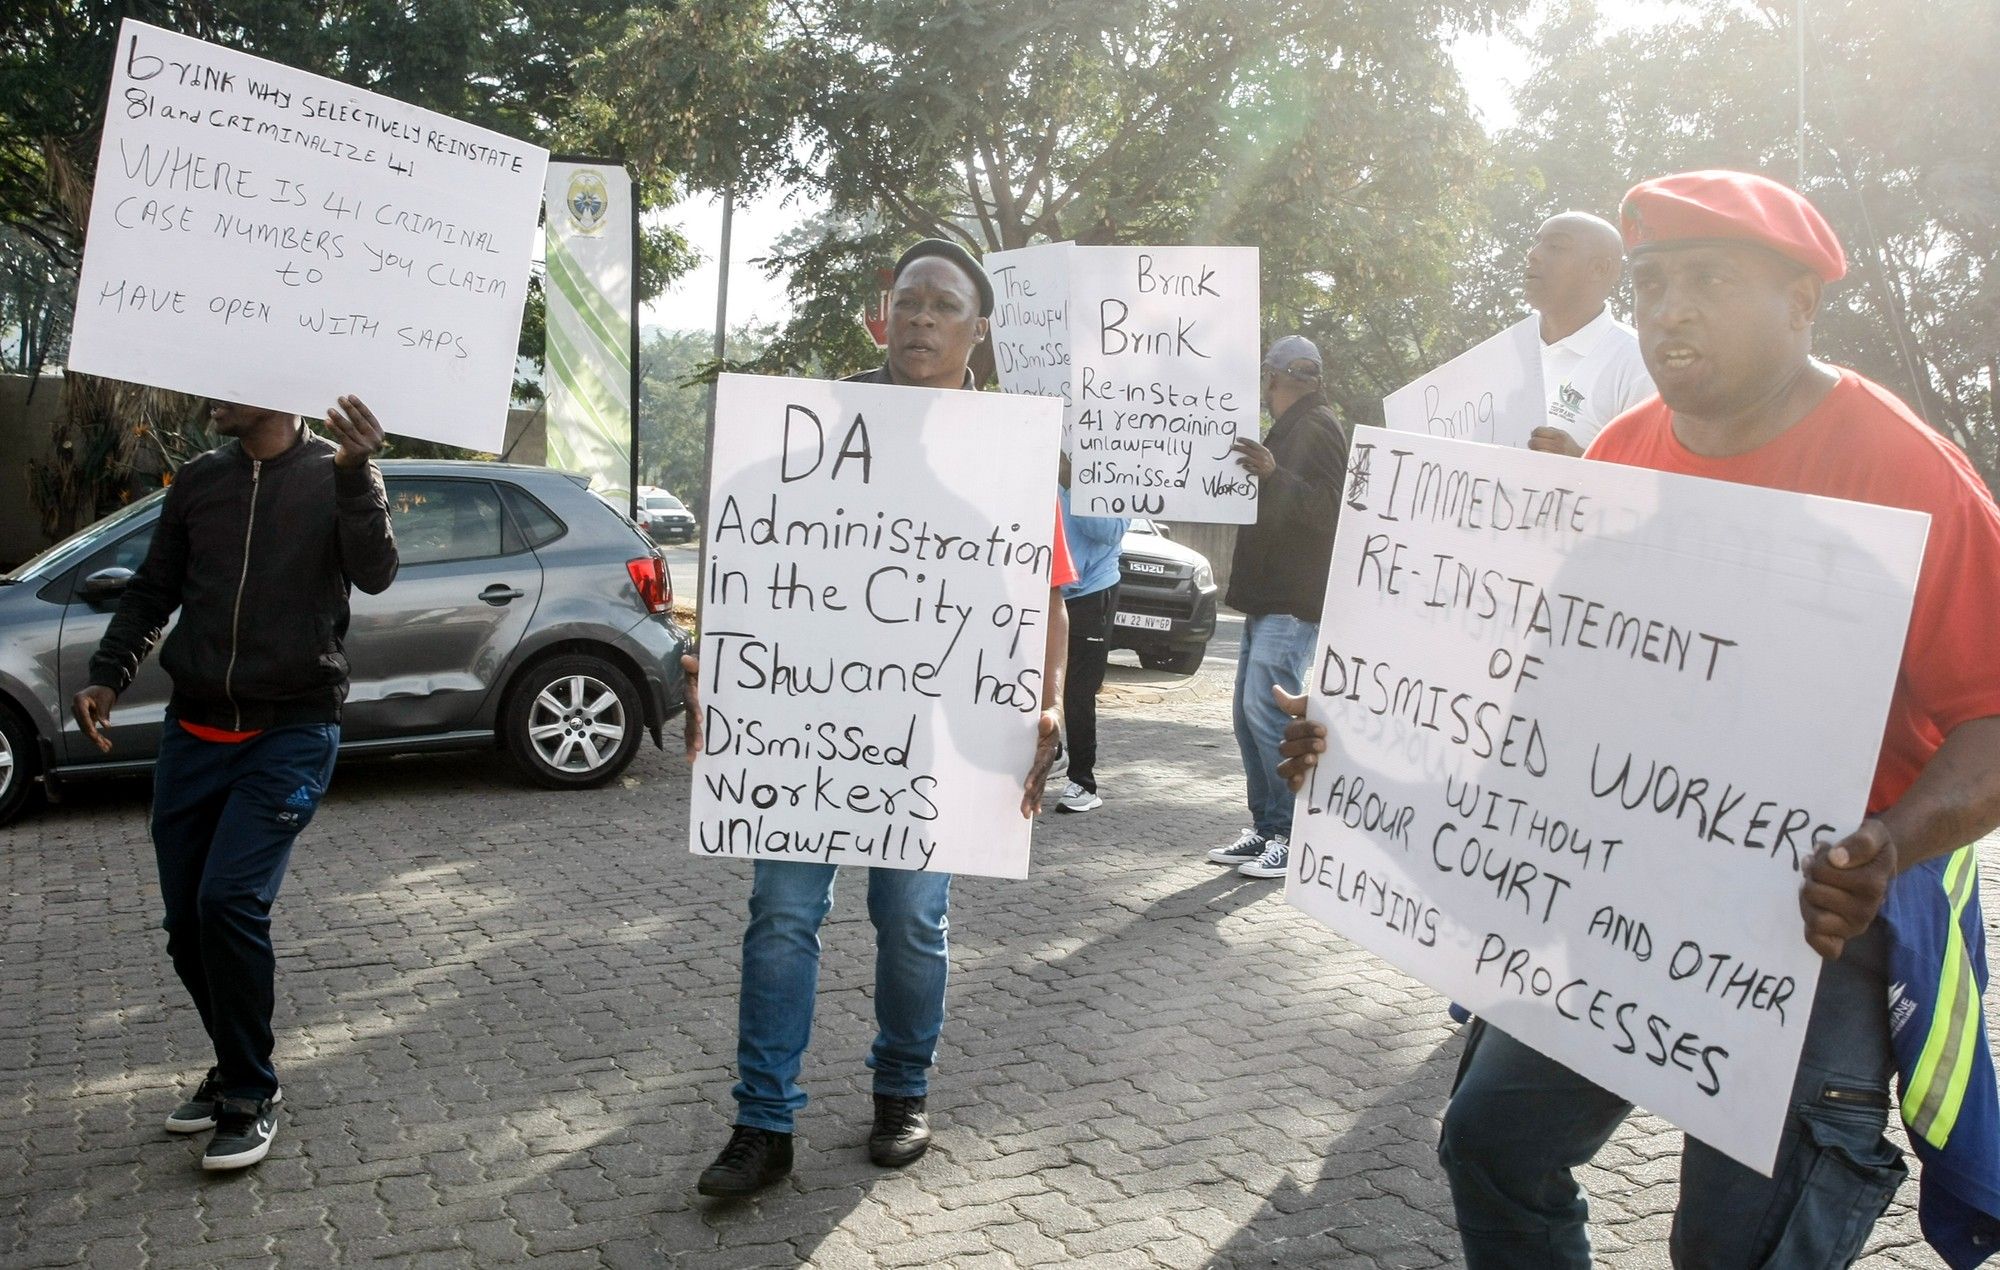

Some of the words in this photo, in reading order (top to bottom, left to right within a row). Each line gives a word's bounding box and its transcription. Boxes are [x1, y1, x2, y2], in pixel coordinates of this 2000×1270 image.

[125, 87, 154, 119] 81
[161, 105, 201, 124] and
[209, 109, 376, 162] CRIMINALIZE
[388, 152, 414, 177] 41
[247, 78, 292, 108] WHY
[302, 96, 421, 143] SELECTIVELY
[120, 138, 258, 198] WHERE
[270, 178, 307, 206] IS
[322, 191, 361, 220] 41
[374, 204, 500, 254] CRIMINAL
[115, 196, 194, 231] CASE
[214, 213, 345, 260] NUMBERS
[427, 263, 507, 298] CLAIM
[275, 261, 323, 287] to
[993, 266, 1037, 299] The
[1138, 254, 1220, 297] Brink
[98, 280, 186, 313] HAVE
[209, 296, 271, 325] OPEN
[299, 308, 379, 338] WITH
[397, 327, 468, 358] SAPS
[999, 341, 1071, 373] Dismisse
[1101, 298, 1212, 358] Brink
[781, 404, 872, 484] DA
[1079, 409, 1103, 431] 41
[1114, 413, 1237, 460] remaining
[1091, 493, 1165, 514] now
[1378, 450, 1592, 532] IMMEDIATE
[715, 493, 1052, 583] Administration
[1130, 563, 1165, 574] ISUZU
[711, 555, 748, 605] in
[767, 561, 848, 612] the
[865, 565, 973, 678] City
[1131, 615, 1141, 626] 22
[1160, 619, 1170, 629] GP
[1357, 534, 1739, 681] RE-INSTATEMENT
[1489, 648, 1544, 692] OF
[1320, 644, 1548, 778] DISMISSED
[1446, 773, 1624, 873] WITHOUT
[1307, 762, 1415, 851] LABOUR
[1432, 822, 1571, 924] COURT
[1588, 905, 1653, 962] AND
[1668, 940, 1795, 1028] OTHER
[1475, 932, 1730, 1097] PROCESSES
